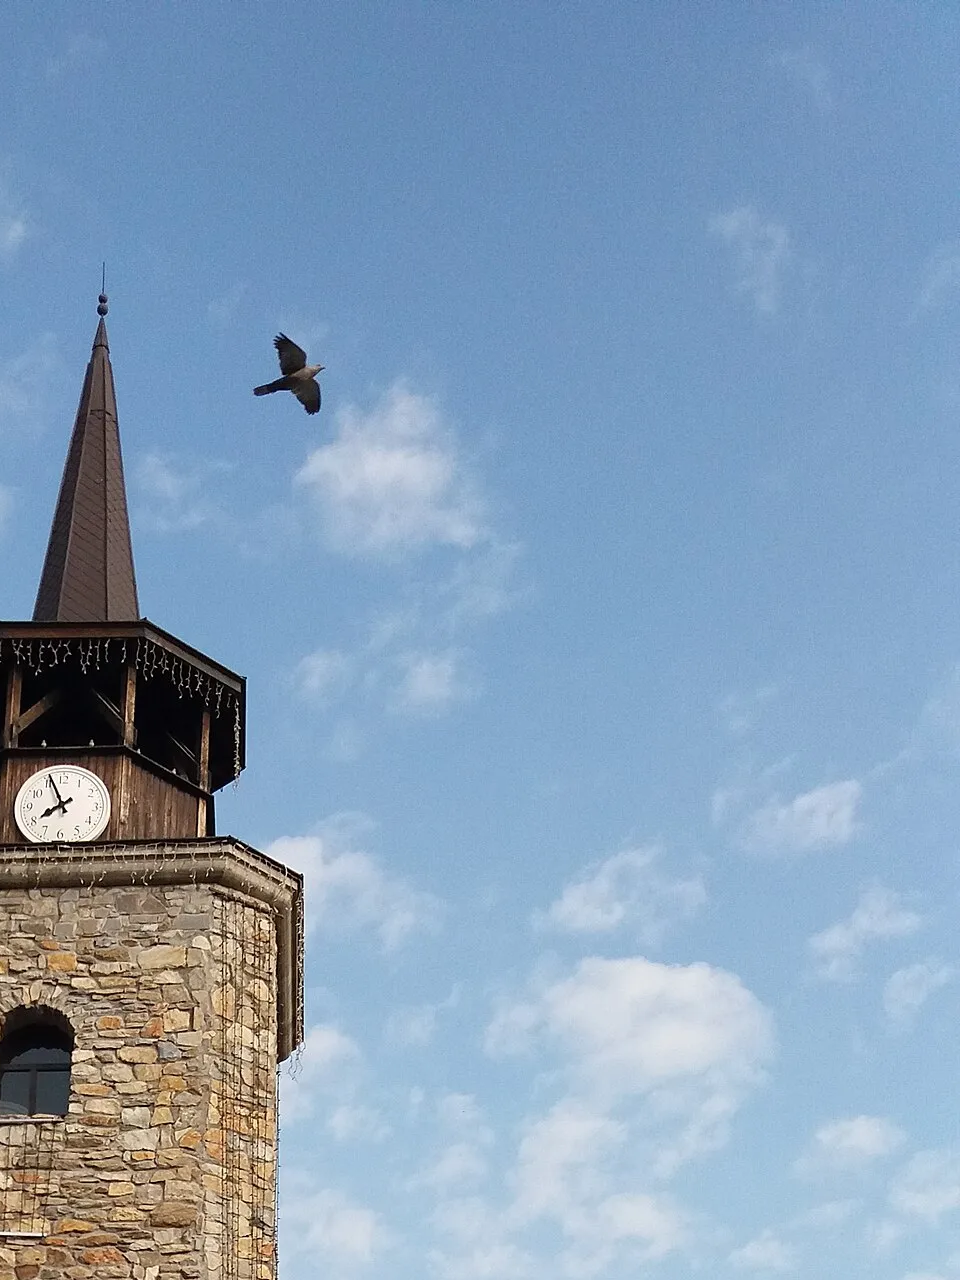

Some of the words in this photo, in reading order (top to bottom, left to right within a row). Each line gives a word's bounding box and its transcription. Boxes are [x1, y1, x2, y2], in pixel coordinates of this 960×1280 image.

[45, 779, 52, 788] 11
[59, 775, 69, 785] 12
[32, 789, 43, 799] 10
[88, 788, 94, 798] 2
[26, 802, 33, 812] 9
[92, 802, 99, 812] 3
[31, 816, 37, 827] 8
[85, 815, 92, 825] 4
[42, 826, 49, 836] 7
[56, 829, 64, 840] 6
[73, 826, 80, 836] 5
